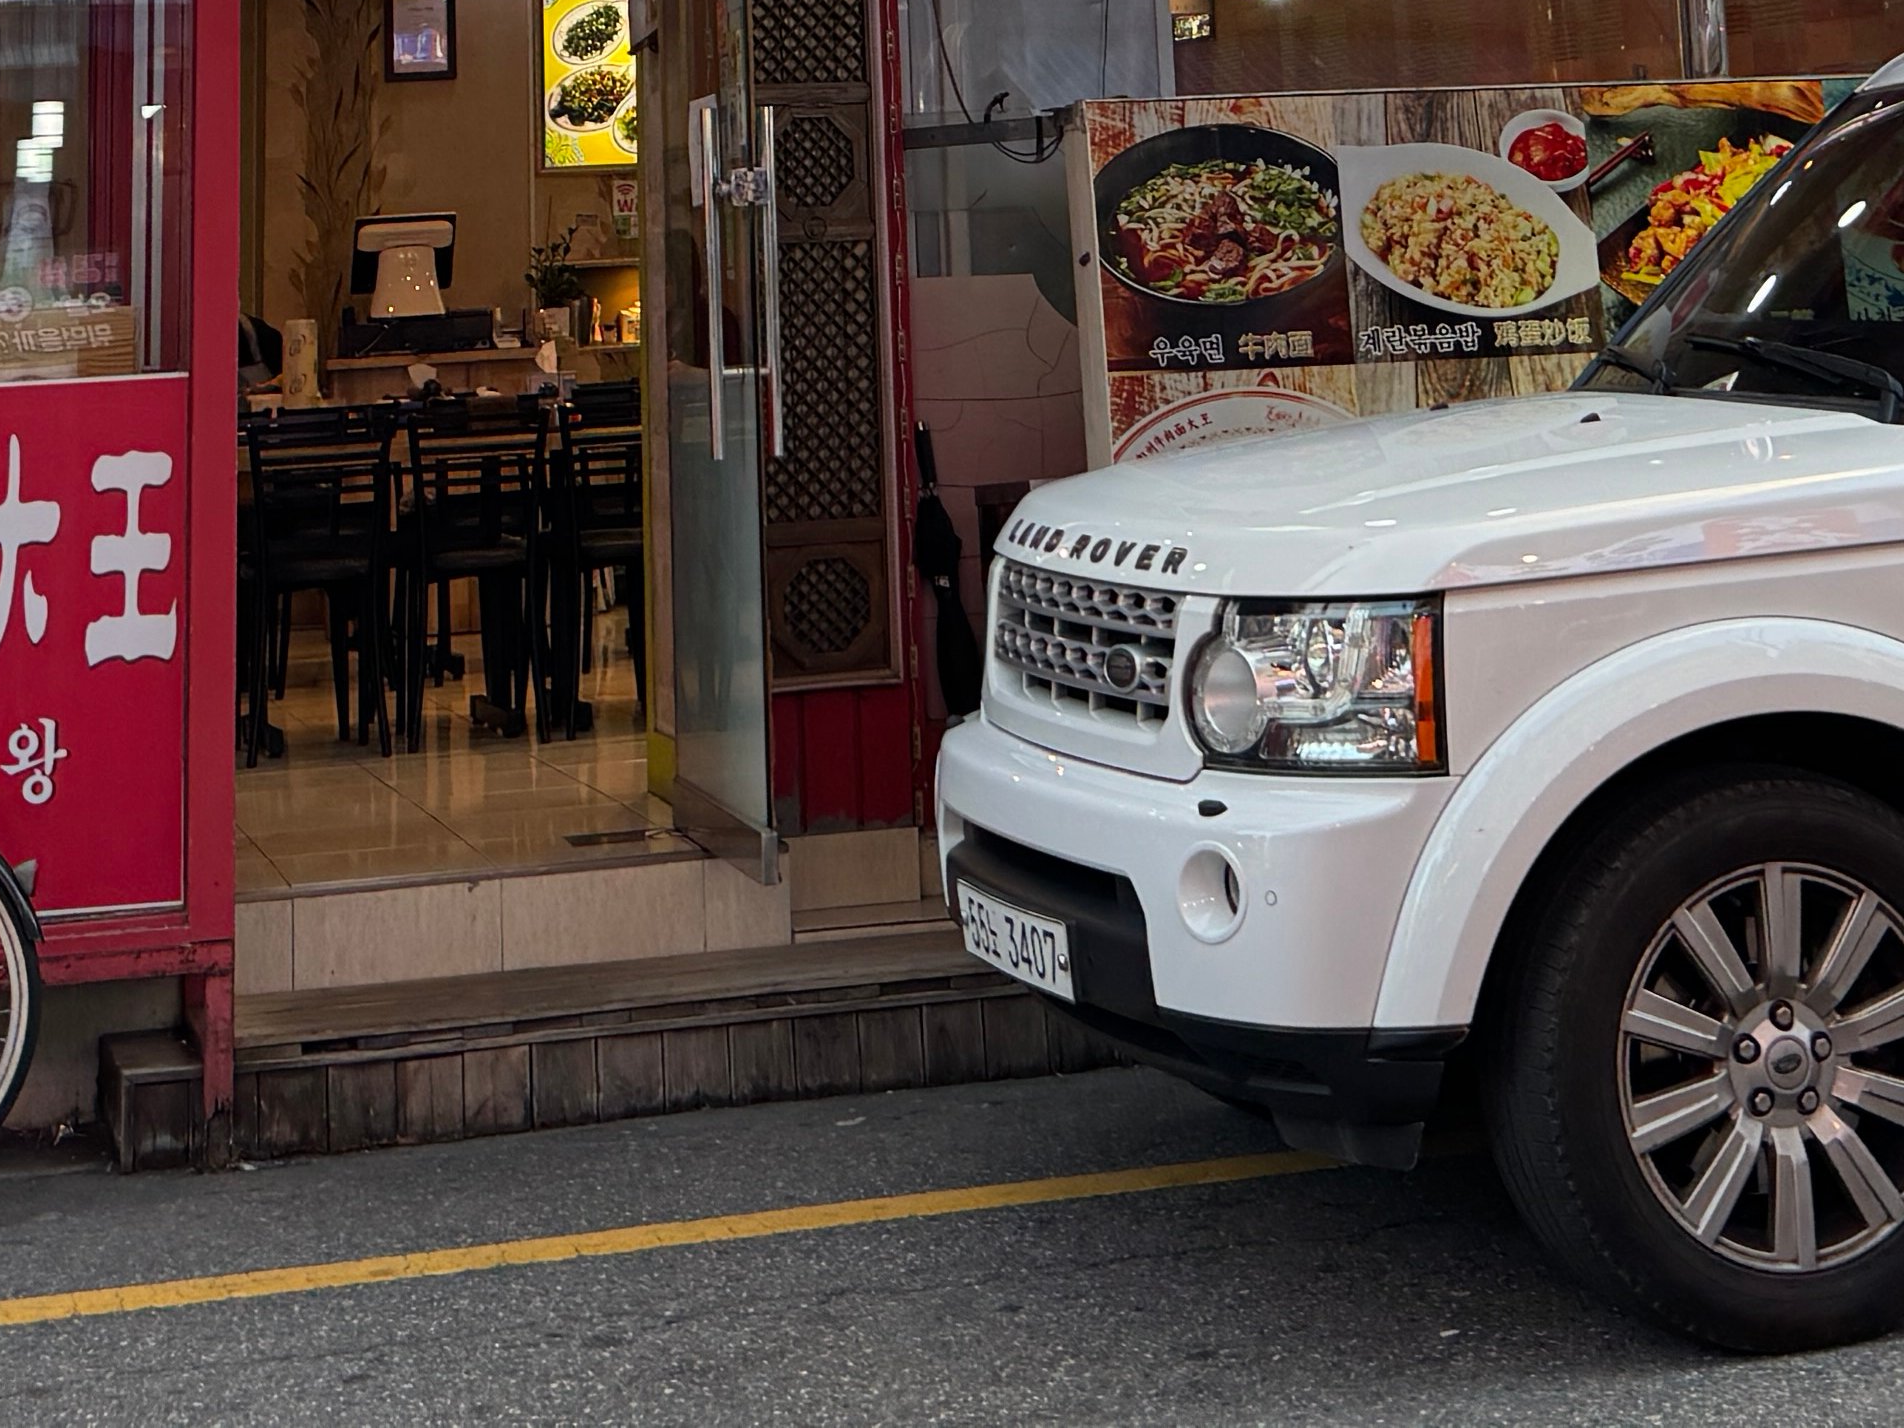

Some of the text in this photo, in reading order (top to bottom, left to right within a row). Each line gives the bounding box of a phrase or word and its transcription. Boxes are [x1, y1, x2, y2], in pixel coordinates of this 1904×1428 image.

[1147, 333, 1227, 368] 우육면
[1238, 330, 1315, 361] 牛肉面
[1359, 321, 1482, 356] 계란볶음밥
[1008, 518, 1189, 575] LAND ROVER
[1004, 915, 1056, 985] 3407
